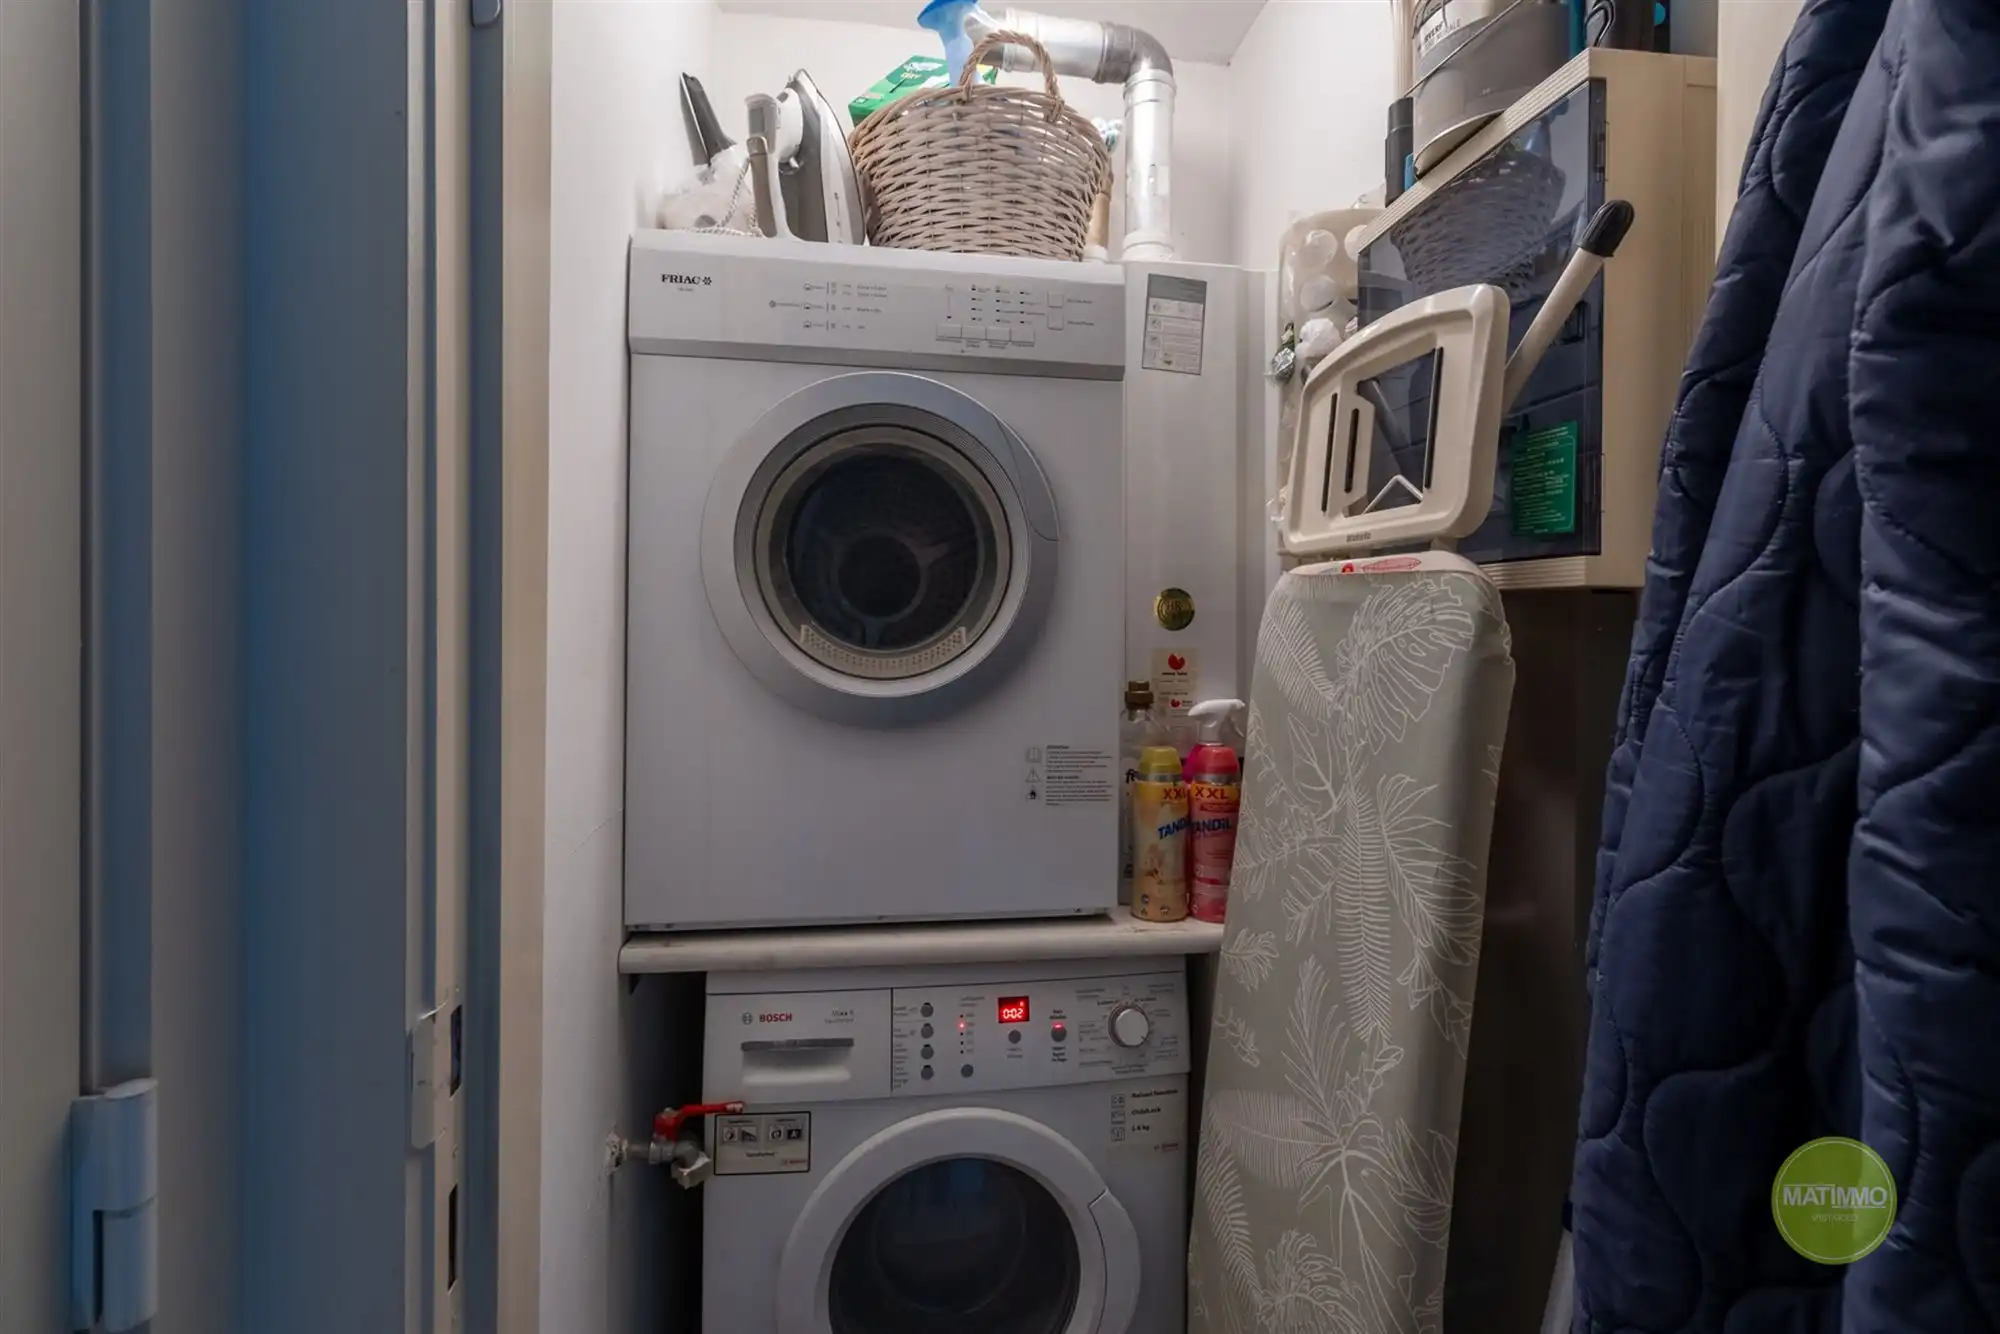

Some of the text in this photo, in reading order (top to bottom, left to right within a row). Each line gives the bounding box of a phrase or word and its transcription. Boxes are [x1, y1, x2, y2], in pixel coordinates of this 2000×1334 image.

[660, 273, 701, 285] FRIAC
[1194, 786, 1228, 800] XXL
[1157, 816, 1188, 840] TAND
[759, 1012, 793, 1023] BOSCH
[1003, 1008, 1024, 1019] 0:02
